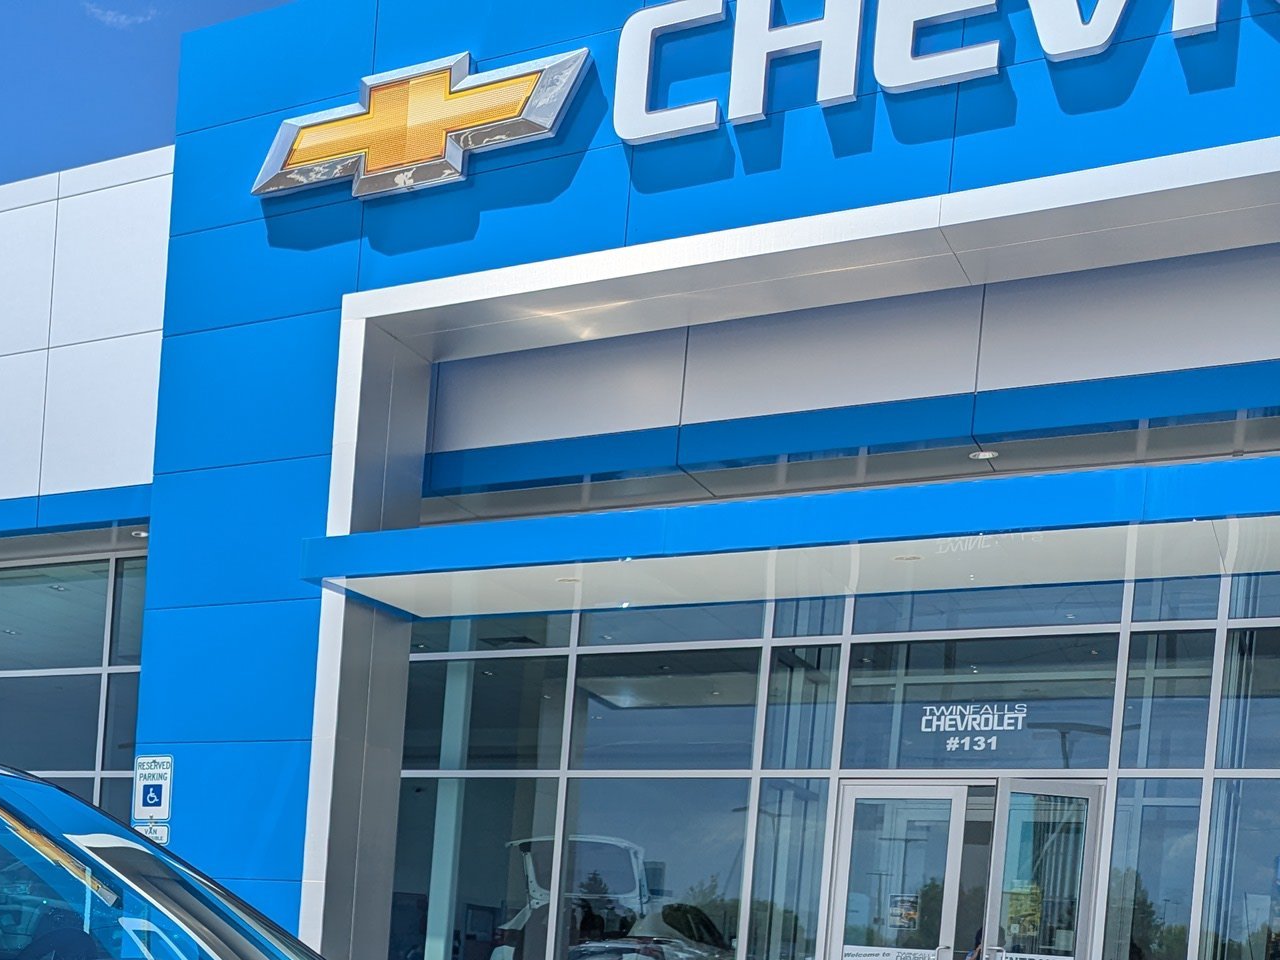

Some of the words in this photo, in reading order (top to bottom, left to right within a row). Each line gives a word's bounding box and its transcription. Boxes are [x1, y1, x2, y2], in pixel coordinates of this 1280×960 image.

[922, 703, 1027, 716] TWINFALLS
[921, 713, 1027, 732] CHEVROLET
[946, 736, 997, 751] #131
[138, 761, 171, 770] RESERVED
[139, 772, 168, 781] PARKING
